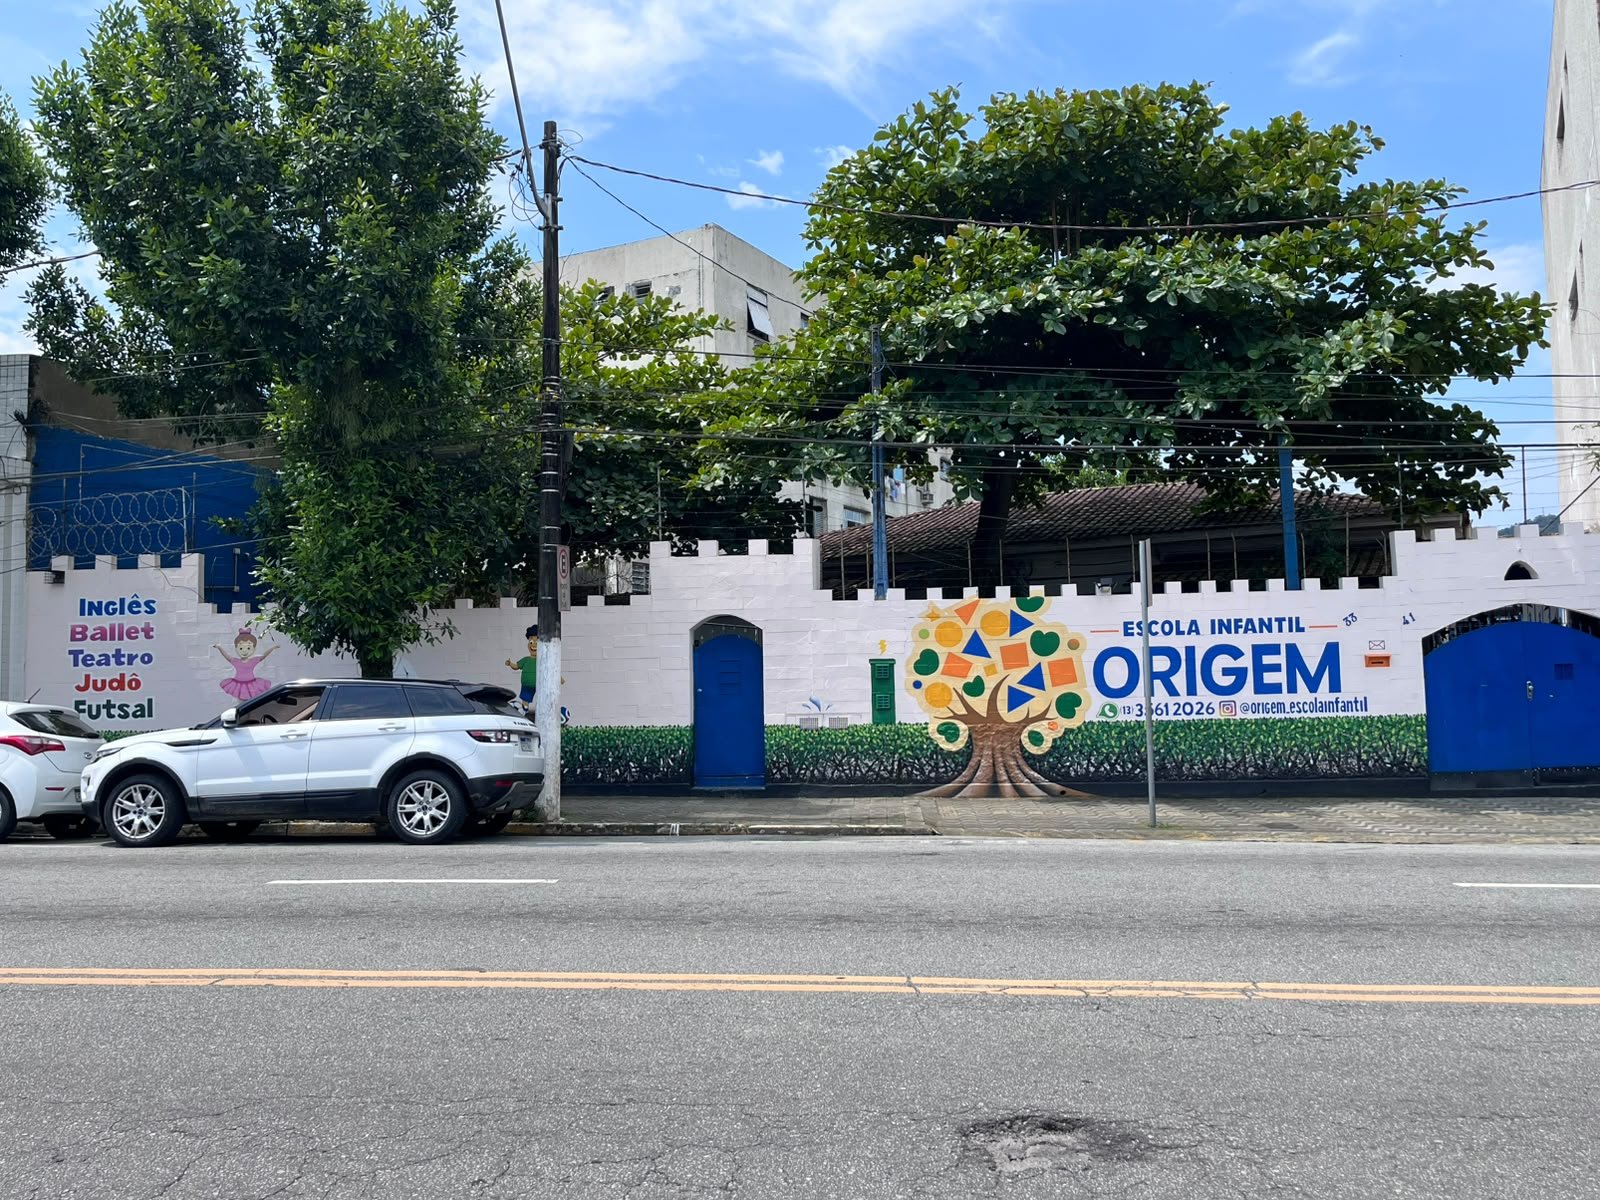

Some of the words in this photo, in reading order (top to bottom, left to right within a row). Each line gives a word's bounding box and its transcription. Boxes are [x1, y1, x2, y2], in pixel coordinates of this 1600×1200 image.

[70, 621, 155, 642] Ballet
[1123, 619, 1201, 637] ESCOLA
[1210, 616, 1306, 635] INFANTIL
[68, 648, 154, 667] Teatro
[1092, 641, 1342, 699] ORIGEM
[74, 672, 142, 692] Judô
[74, 698, 154, 720] Futsal
[1120, 705, 1134, 716] (13)
[1172, 701, 1216, 716] 2026
